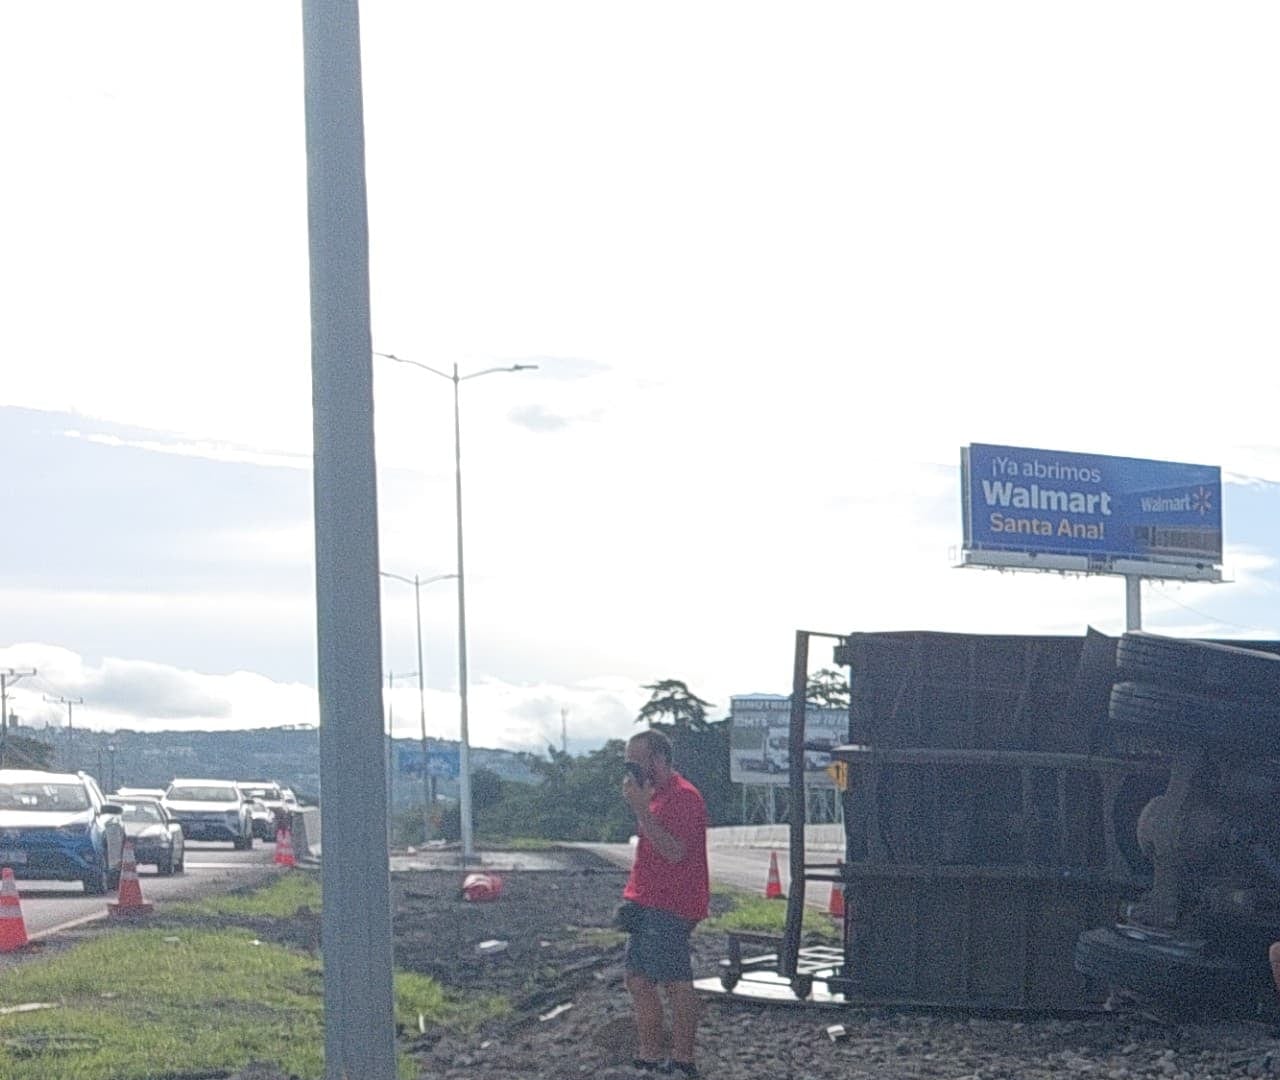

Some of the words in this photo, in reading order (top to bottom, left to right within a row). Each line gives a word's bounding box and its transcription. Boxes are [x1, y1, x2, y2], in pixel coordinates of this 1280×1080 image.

[992, 457, 1018, 477] ¡Ya
[1023, 460, 1101, 483] abrimos
[981, 479, 1112, 515] Walmart
[1141, 494, 1191, 512] Walmart
[990, 512, 1052, 536] Santa
[1058, 518, 1104, 540] Ana!
